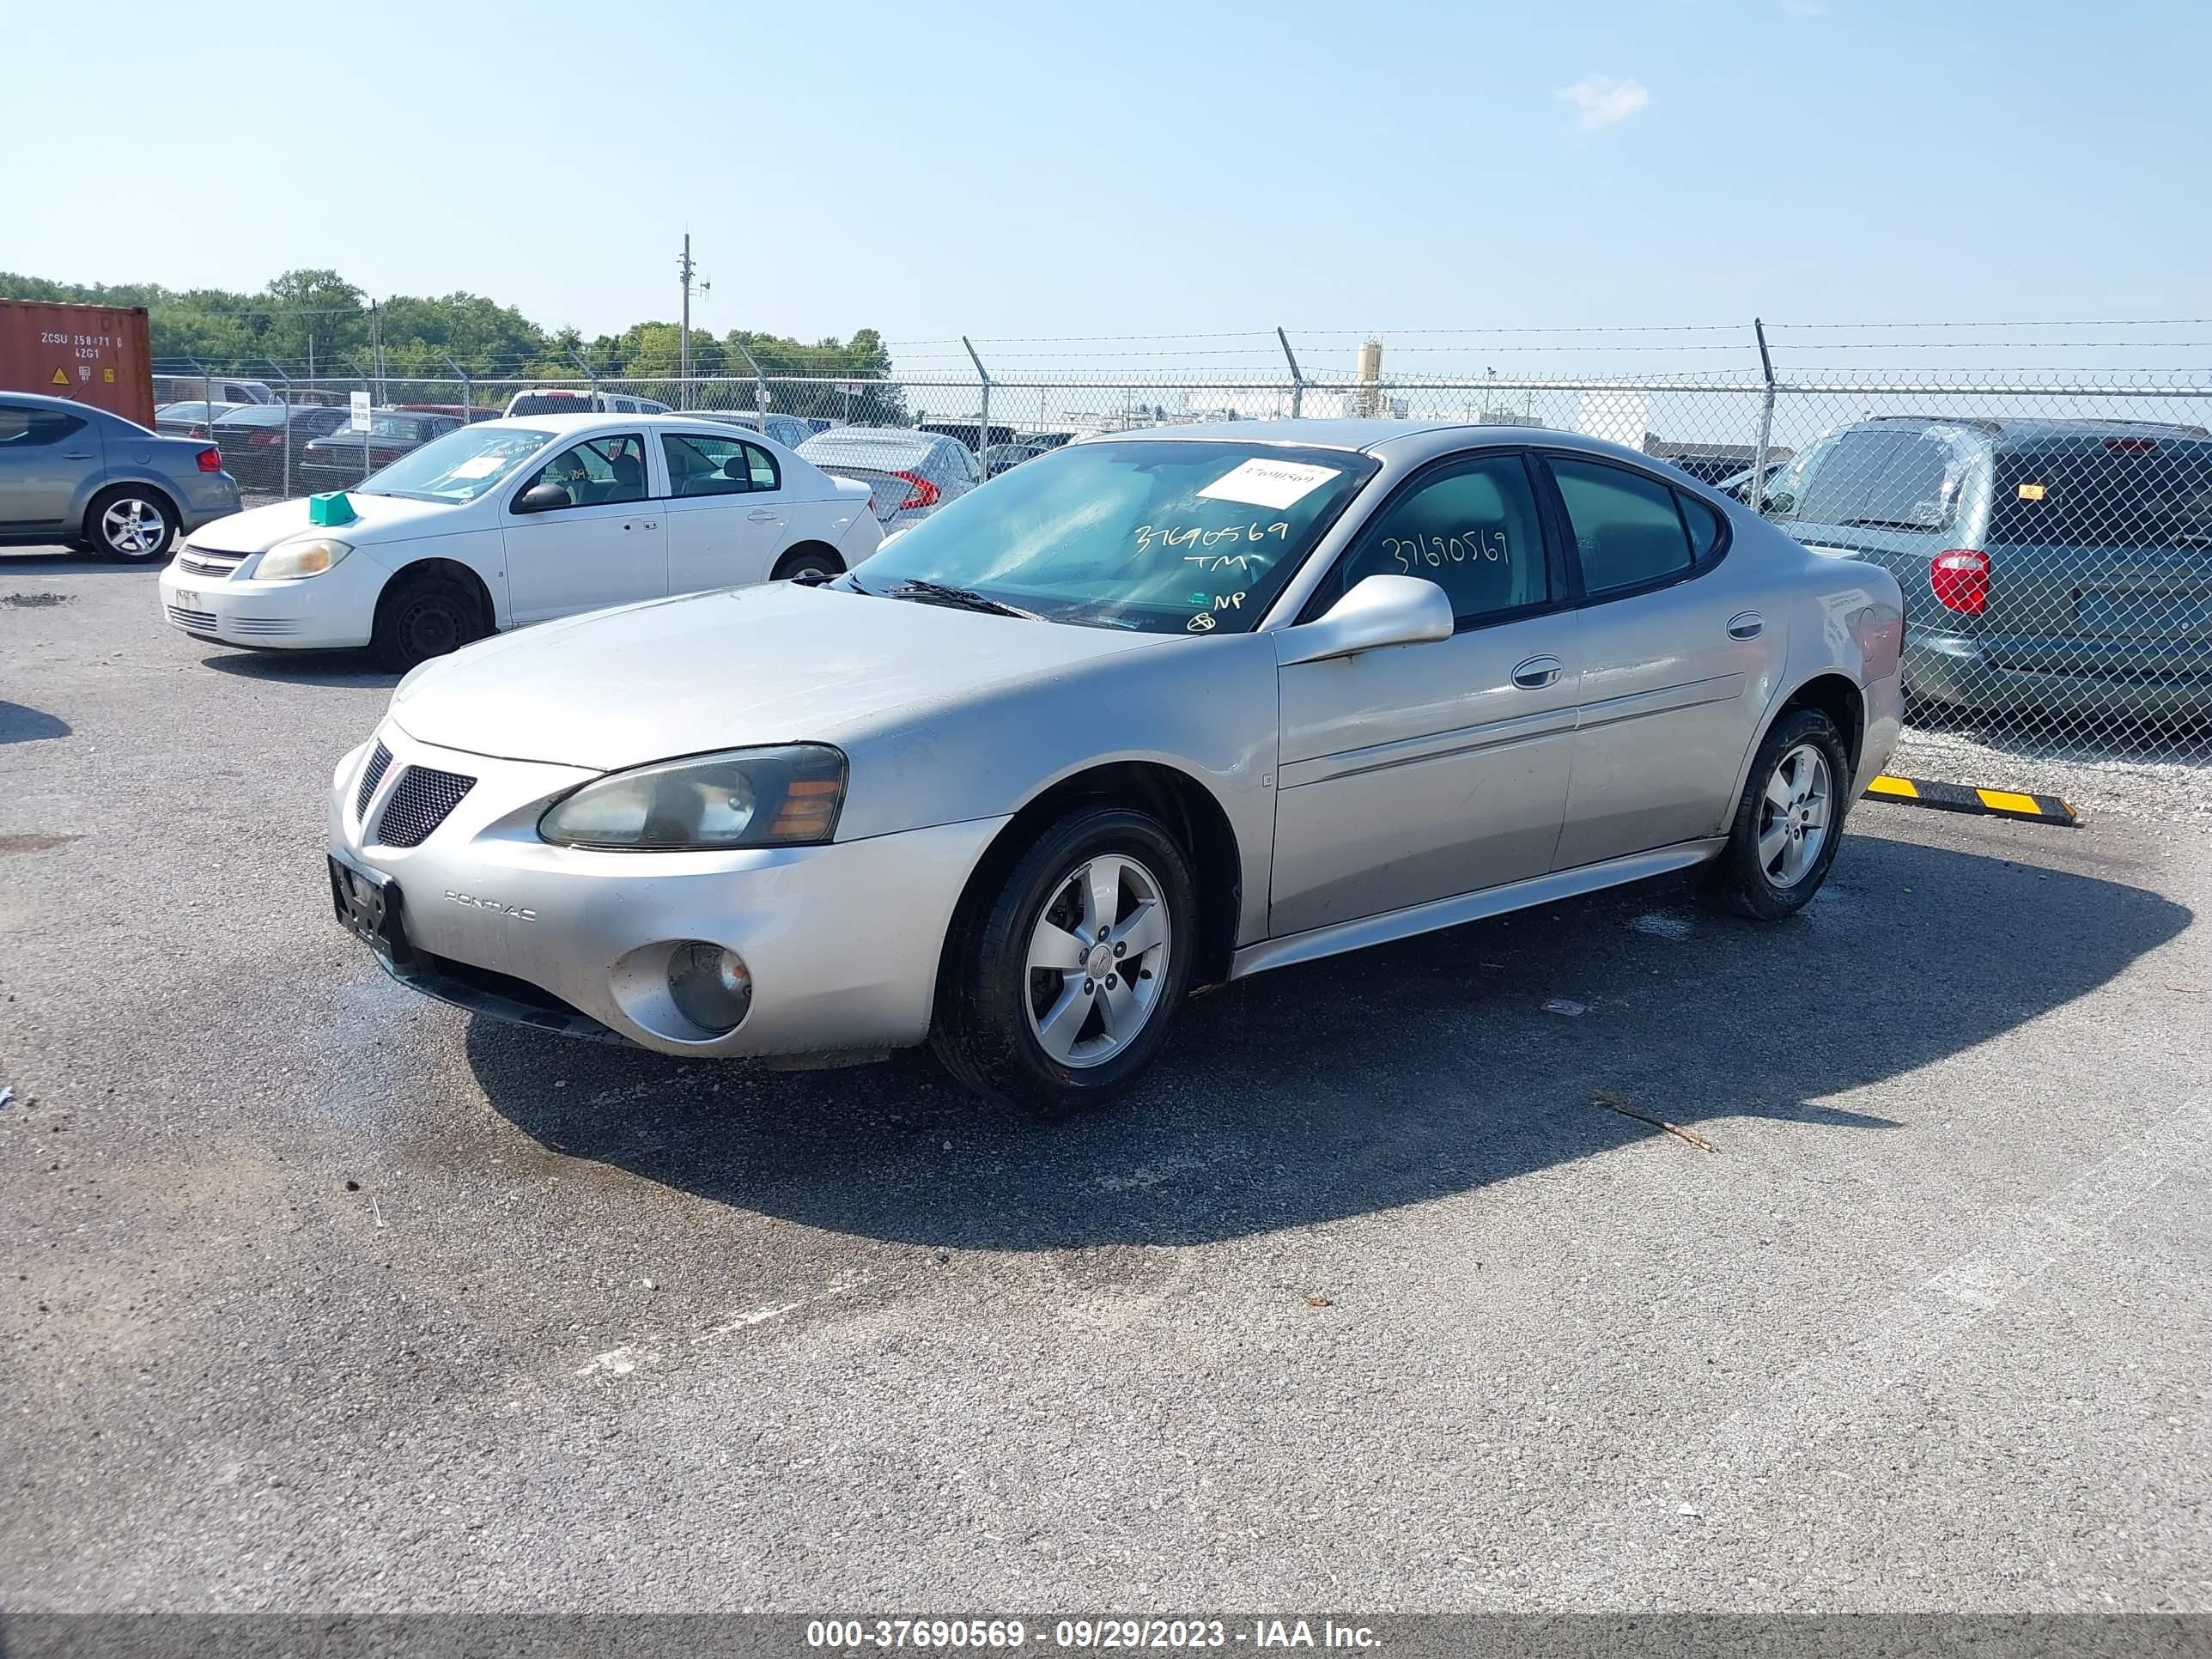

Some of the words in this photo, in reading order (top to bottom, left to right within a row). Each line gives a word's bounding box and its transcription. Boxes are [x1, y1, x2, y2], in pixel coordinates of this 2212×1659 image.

[40, 332, 68, 343] ZCSU
[75, 349, 99, 358] 42G1
[1133, 522, 1289, 557] 37690569
[1382, 529, 1509, 574] 37690569
[1183, 556, 1248, 572] TM
[1213, 591, 1246, 611] NP
[444, 890, 537, 921] PONTIAC
